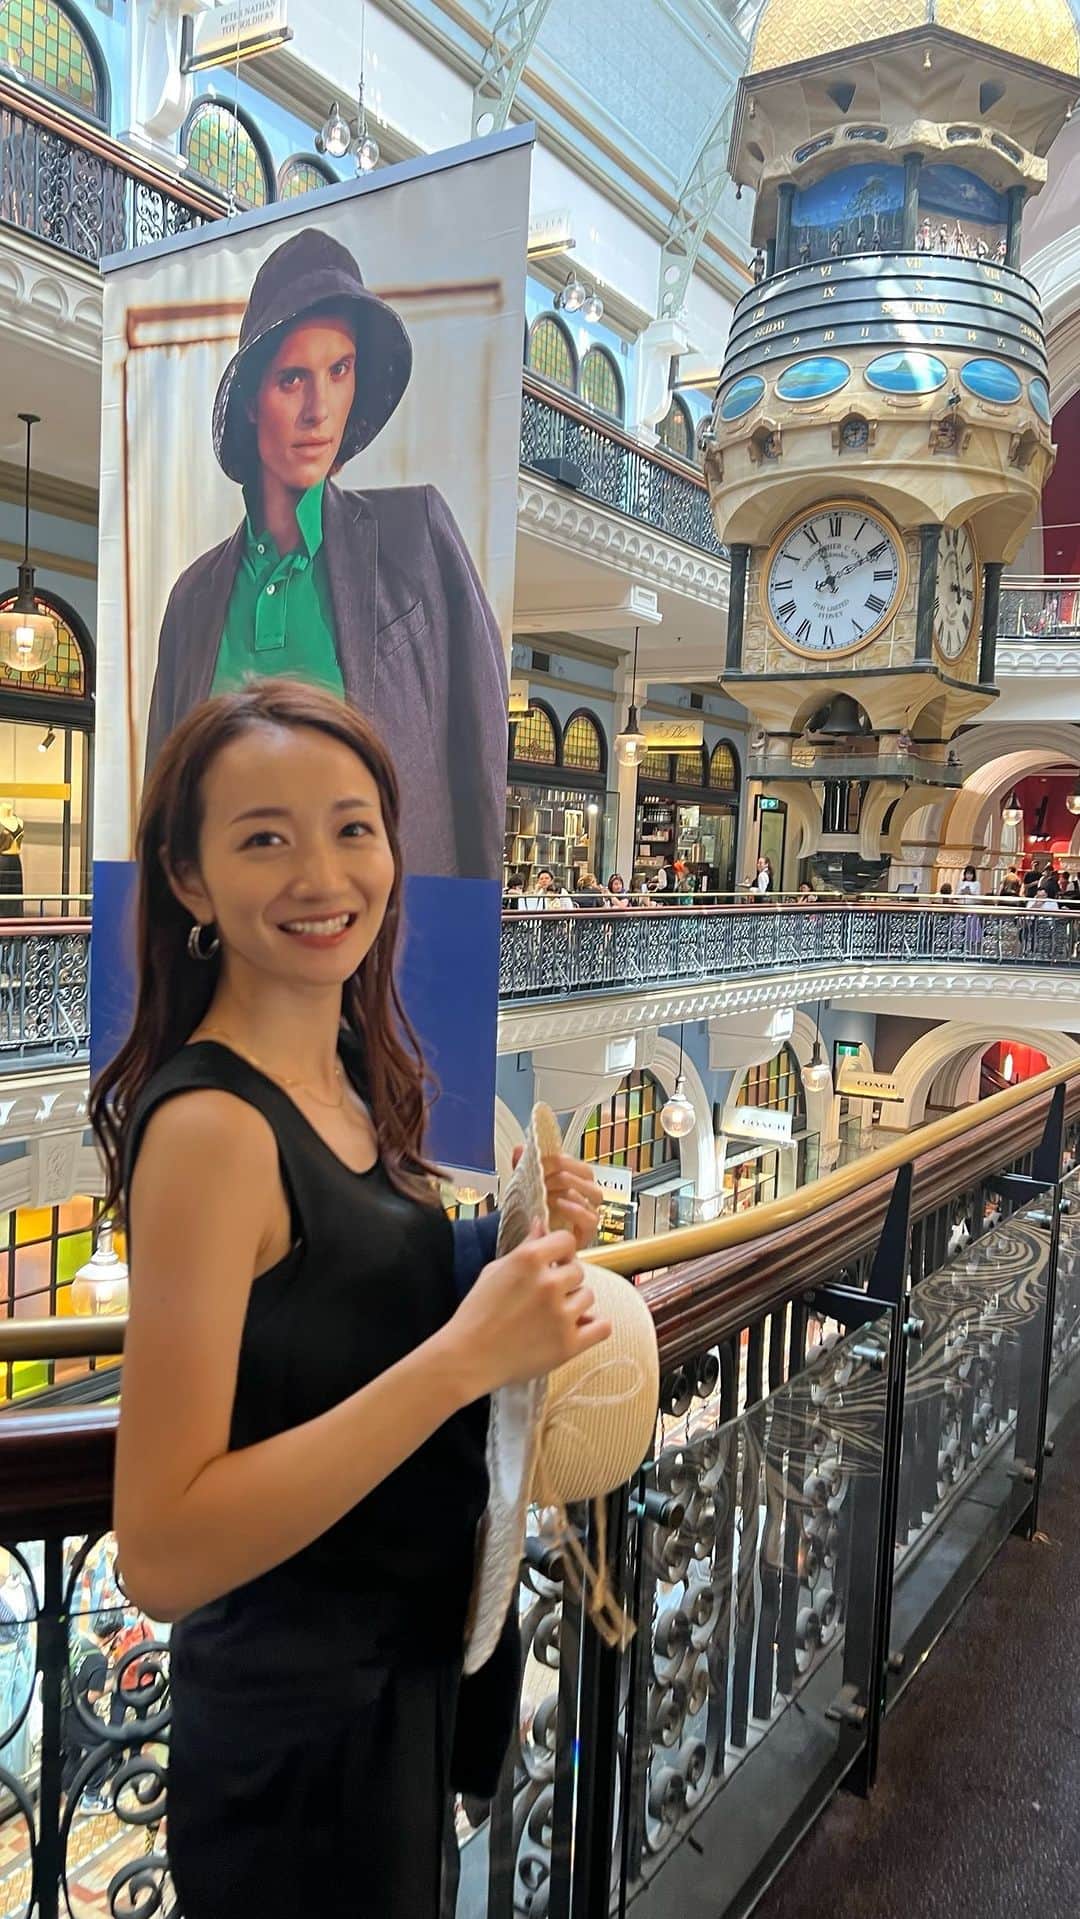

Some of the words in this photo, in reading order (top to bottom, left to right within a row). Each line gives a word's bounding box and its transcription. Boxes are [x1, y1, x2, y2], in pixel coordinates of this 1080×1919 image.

[244, 0, 276, 15] NATHAN
[222, 22, 237, 34] TOY
[239, 11, 275, 28] SOLDIERS
[820, 265, 833, 277] VI
[906, 258, 922, 269] VII
[823, 287, 837, 298] IX
[914, 281, 924, 292] X
[993, 290, 1004, 304] XI
[754, 320, 786, 338] FRIDAY
[881, 302, 947, 315] SAURDAY
[792, 336, 800, 349] 9
[823, 330, 835, 342] 10
[860, 327, 869, 337] 11
[967, 330, 977, 342] 14
[802, 543, 842, 571] CHRISTHER
[873, 570, 892, 581] III
[857, 1080, 896, 1090] COACH
[742, 1119, 786, 1132] COACH
[595, 1178, 624, 1191] ACH
